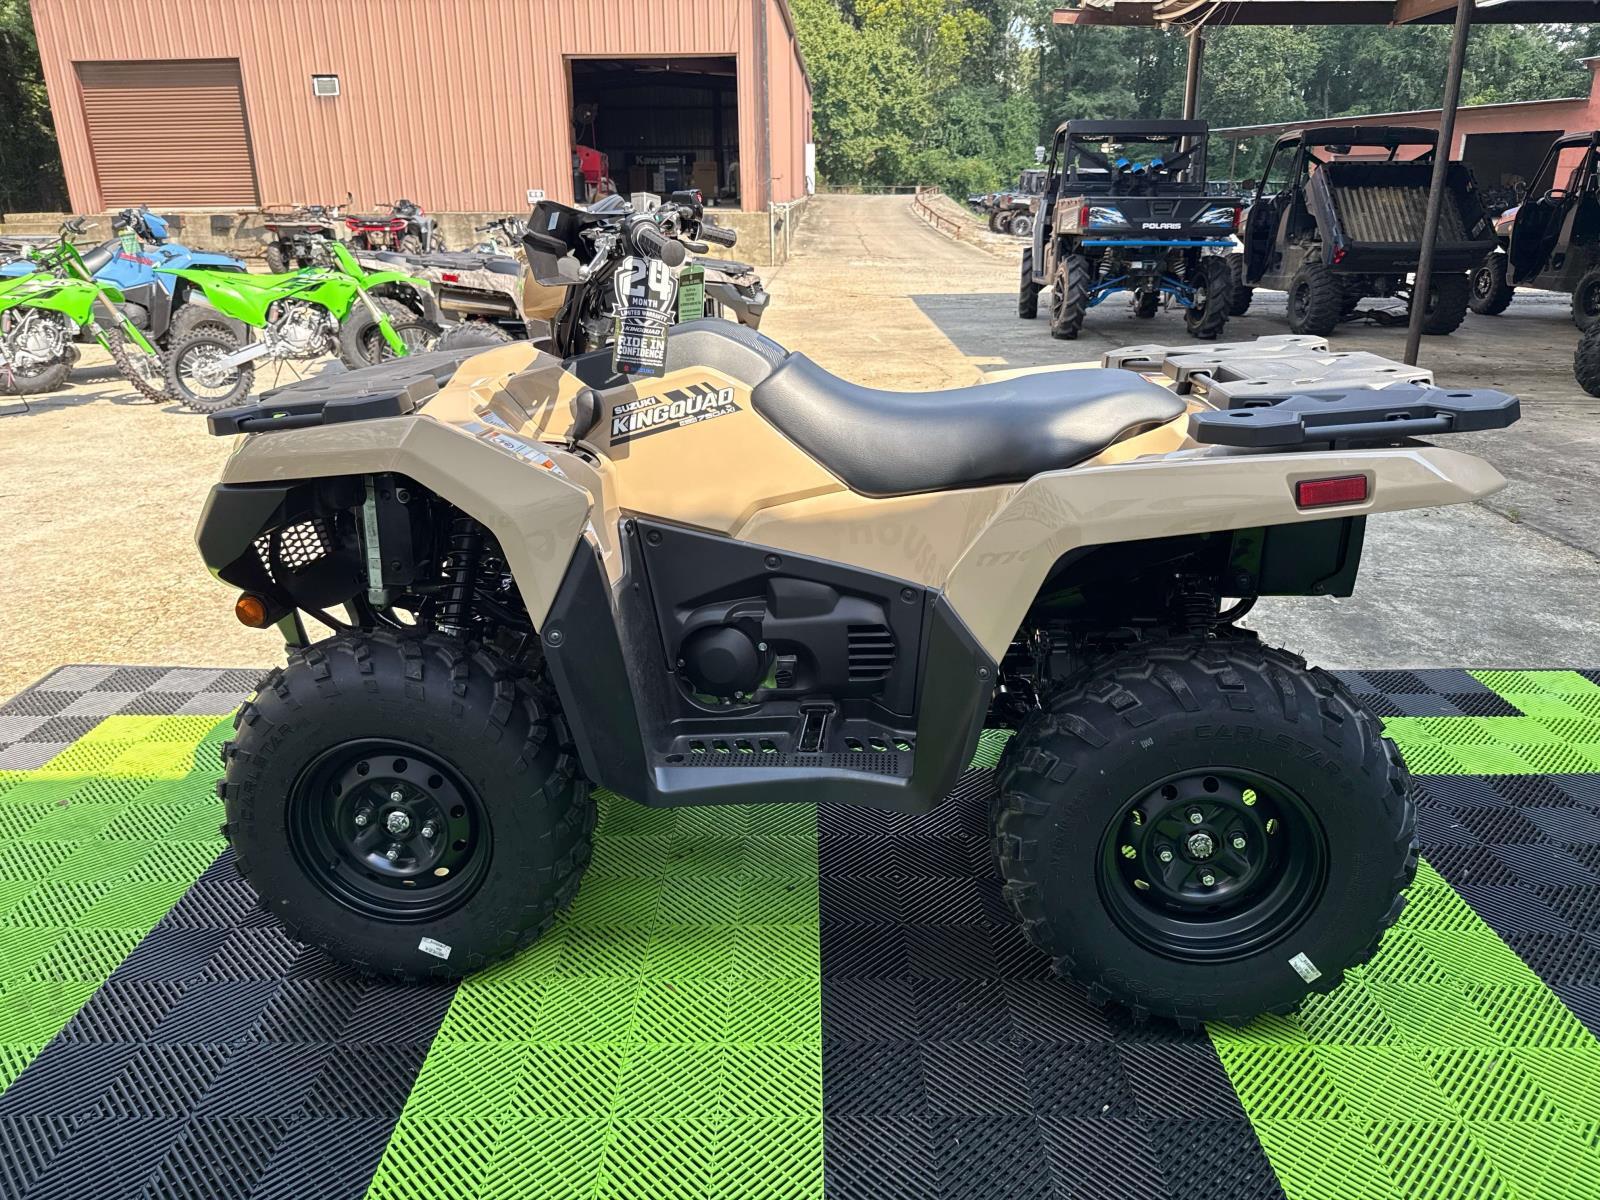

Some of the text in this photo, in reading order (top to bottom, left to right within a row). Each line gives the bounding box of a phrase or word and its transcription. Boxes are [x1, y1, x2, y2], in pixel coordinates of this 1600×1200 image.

[1142, 222, 1182, 230] POLARIS
[623, 256, 672, 301] 24
[632, 297, 658, 308] MONTH
[620, 309, 668, 322] LIMITED WARRANTY
[625, 325, 661, 335] KINGQUAD
[618, 335, 665, 350] RIDE IN
[617, 345, 664, 360] CONFIDENCE
[612, 387, 734, 436] KINGQUAD
[614, 396, 656, 414] SUZUKI
[1194, 723, 1344, 776] CARLSTAR
